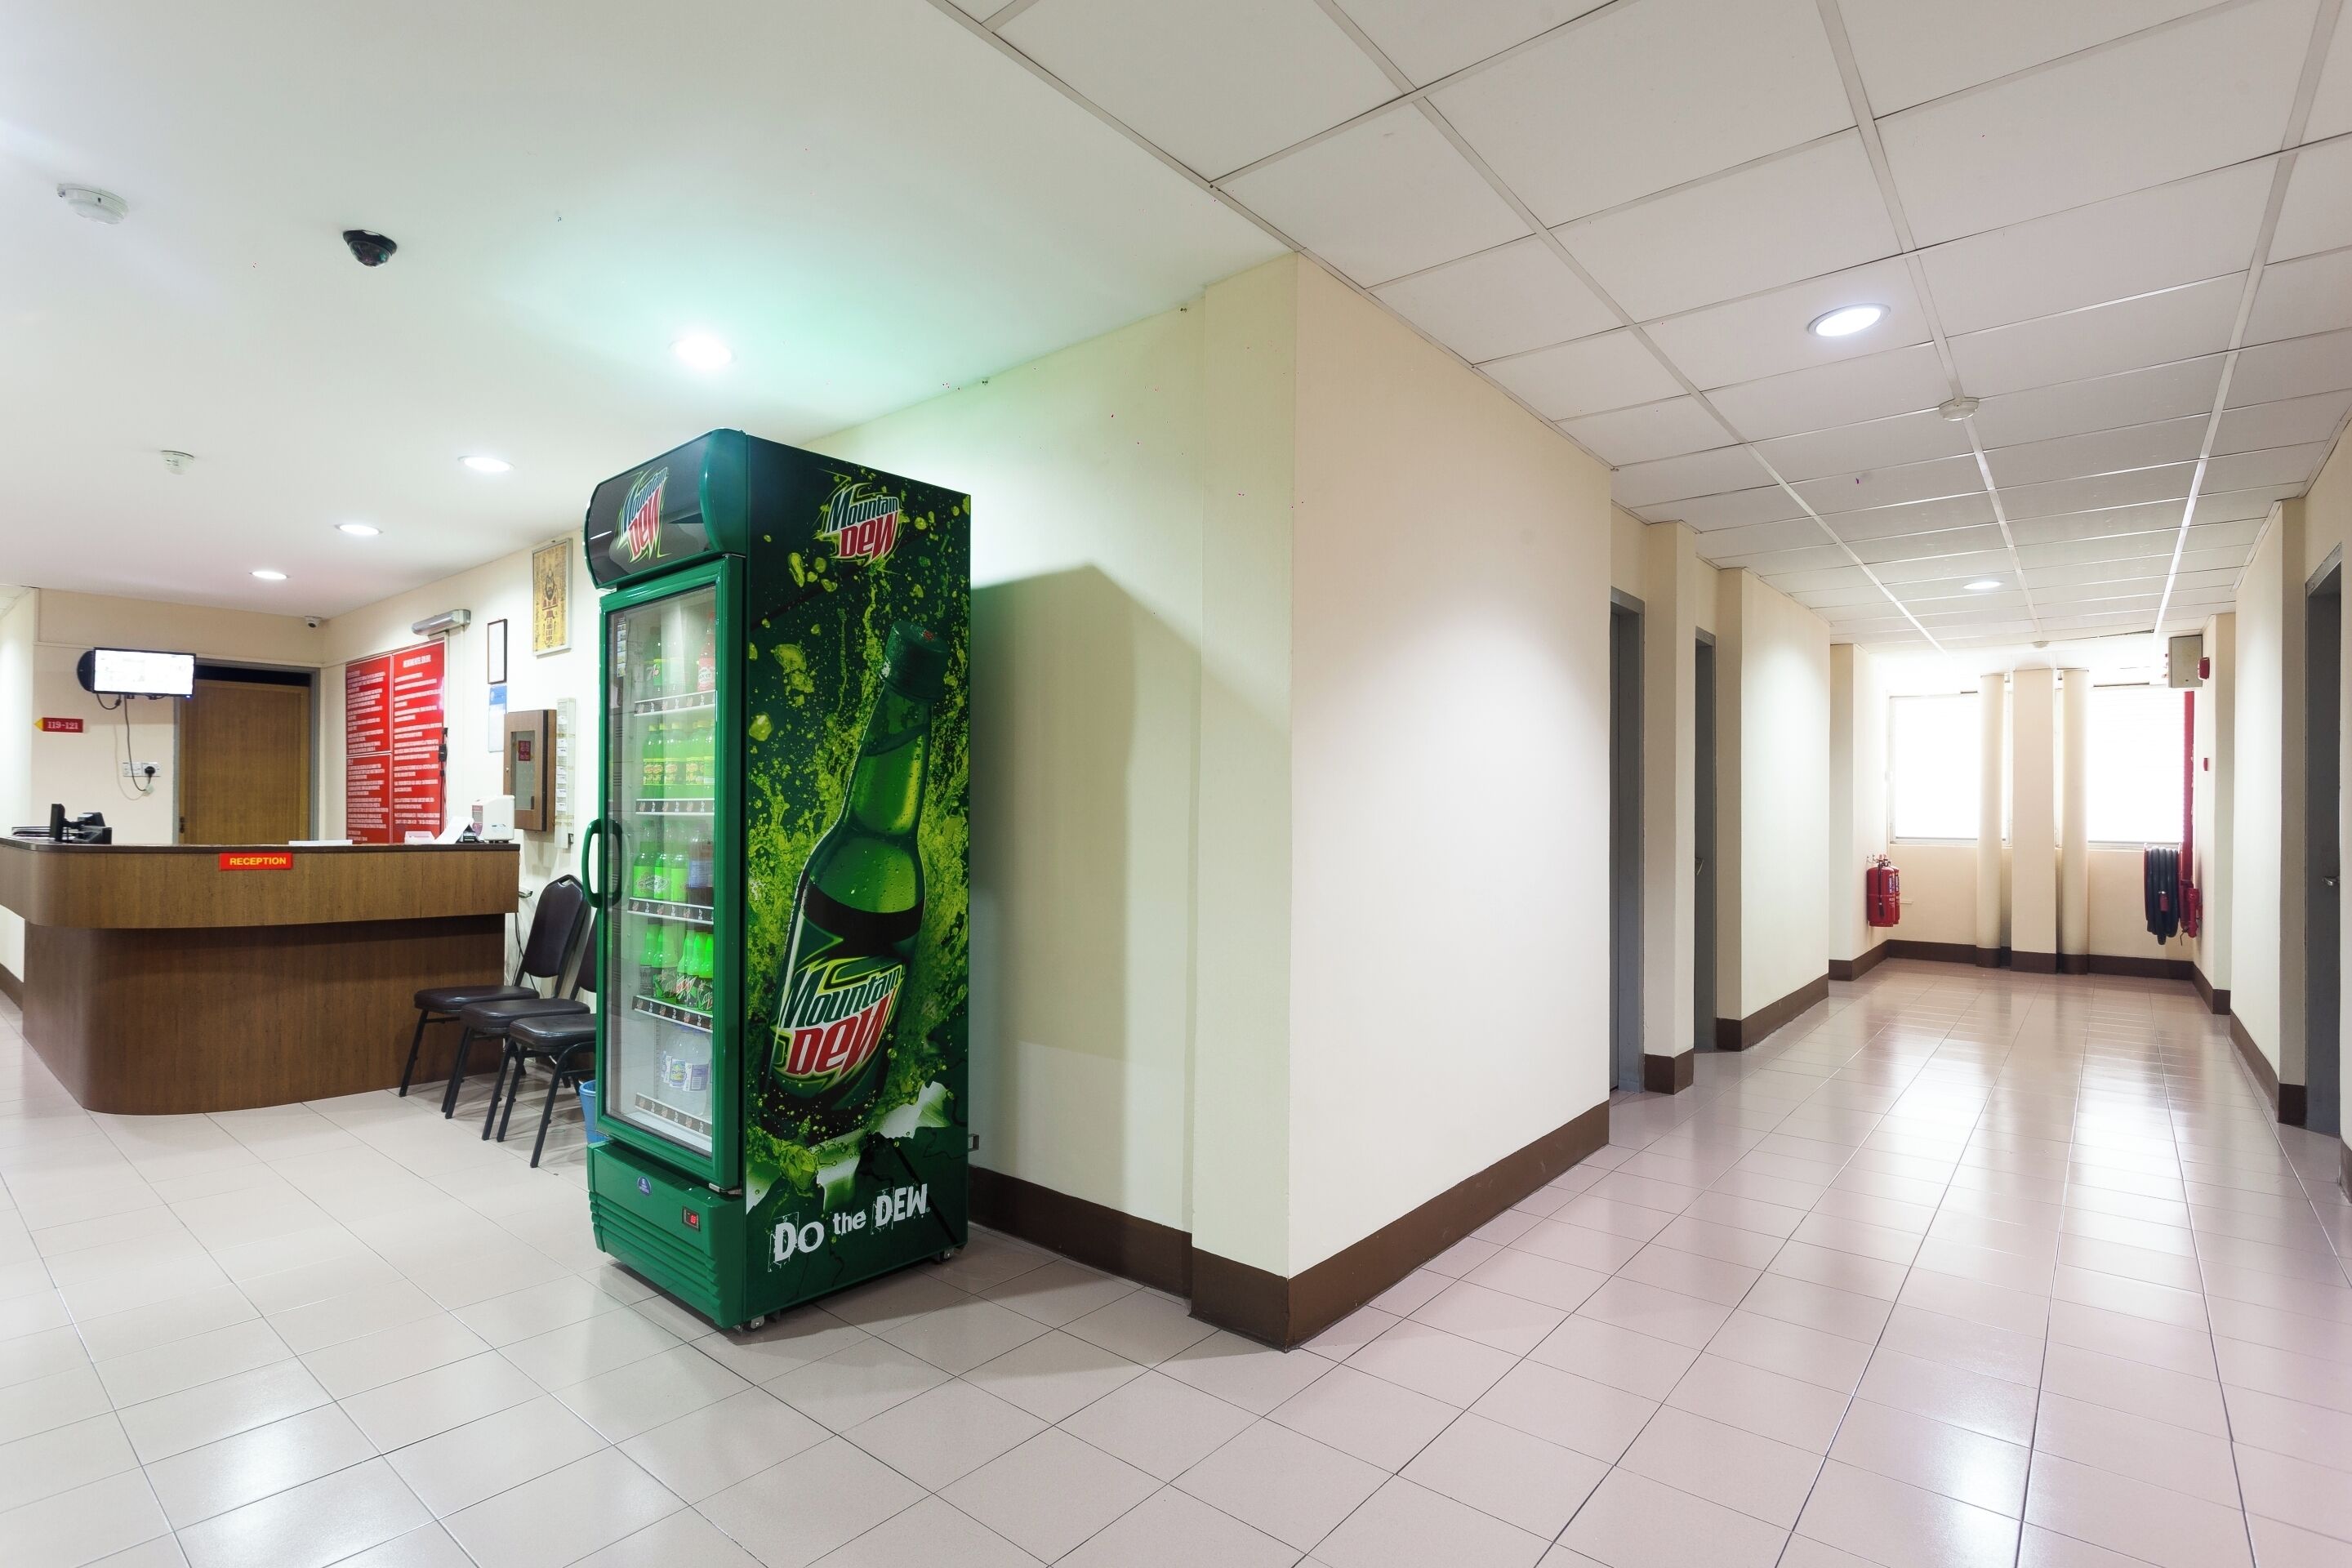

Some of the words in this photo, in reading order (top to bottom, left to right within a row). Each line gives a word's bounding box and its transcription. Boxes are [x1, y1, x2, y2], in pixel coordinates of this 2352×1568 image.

[826, 488, 898, 532] Mountain
[47, 721, 78, 730] 119-121
[229, 857, 287, 866] RECEPTION
[777, 964, 902, 1028] Mountain
[833, 1209, 866, 1236] the
